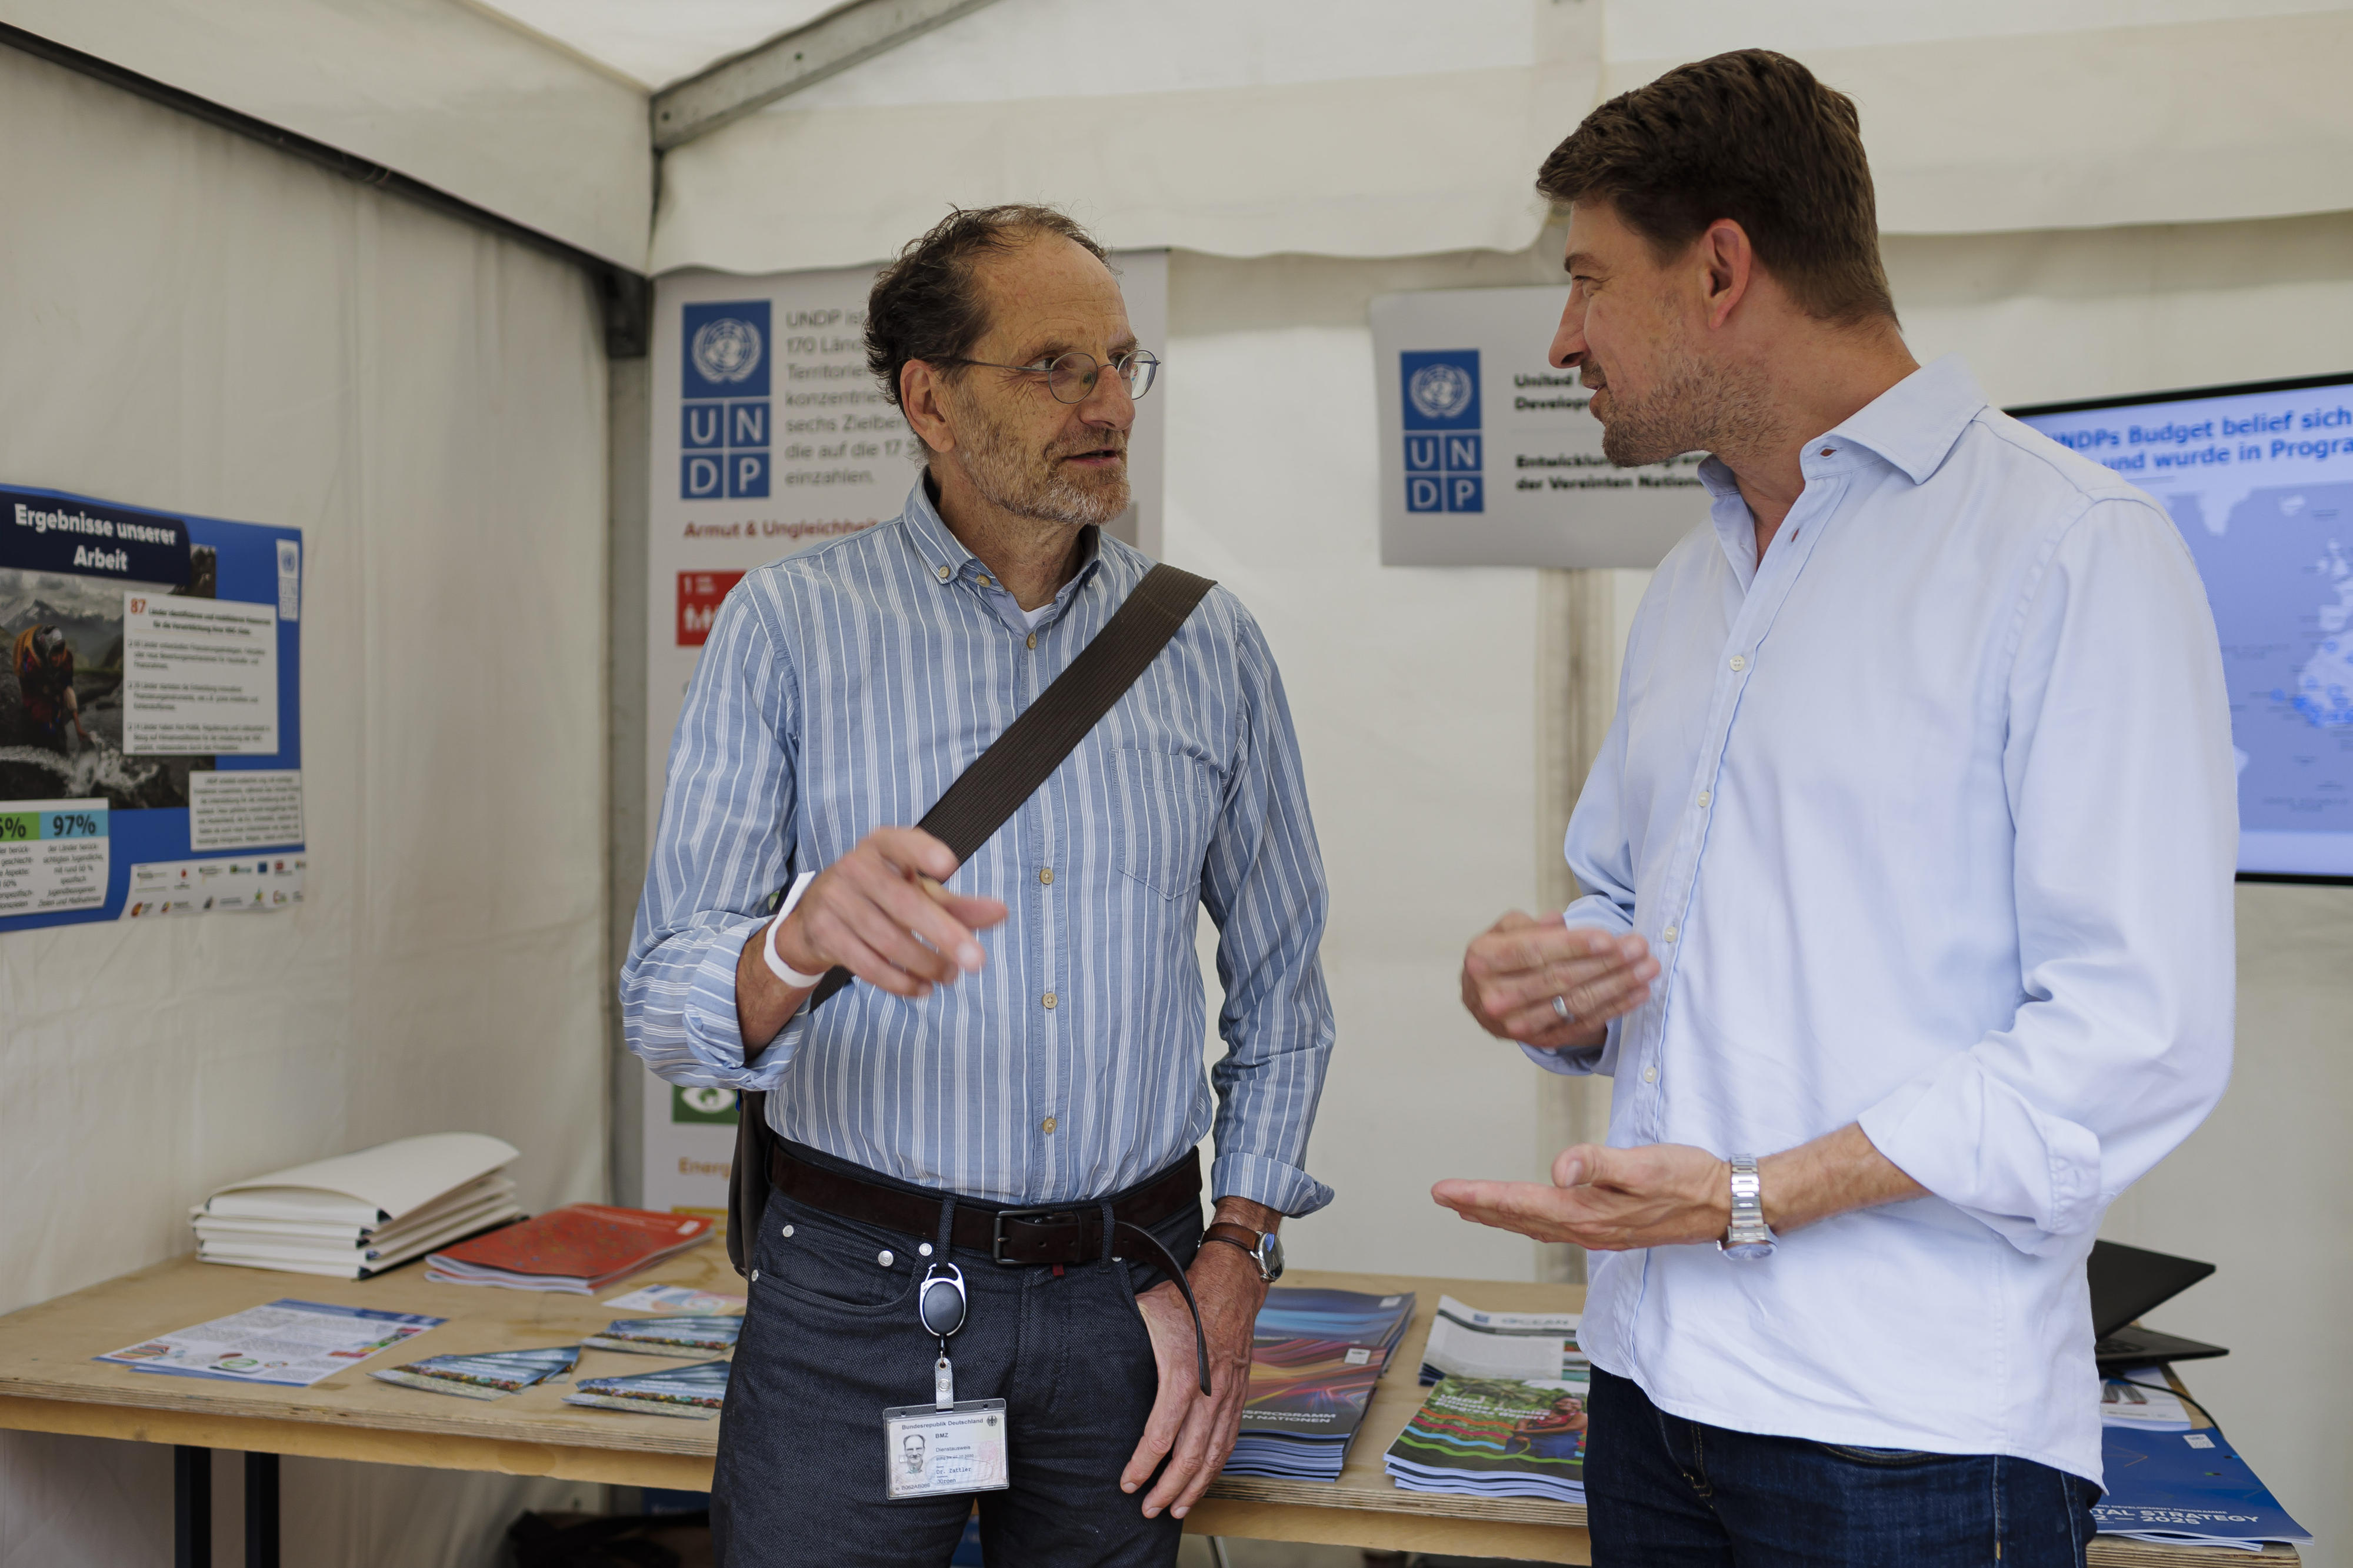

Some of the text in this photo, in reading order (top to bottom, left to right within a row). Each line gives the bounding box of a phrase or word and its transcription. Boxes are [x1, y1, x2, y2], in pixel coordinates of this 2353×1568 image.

[786, 309, 842, 329] UNDP
[786, 336, 816, 355] 170
[786, 363, 868, 381] Territorie
[1514, 372, 1573, 387] United
[785, 389, 884, 408] konzentrie
[785, 413, 903, 434] sechs Zielber
[2128, 419, 2214, 445] Budget
[2222, 411, 2294, 436] belief
[2301, 406, 2352, 429] sich
[785, 442, 813, 461] die
[818, 441, 847, 459] auf
[851, 441, 879, 459] die
[2154, 444, 2230, 467] wurde
[2239, 442, 2261, 461] in
[1516, 475, 1542, 490] der
[1548, 473, 1634, 489] Vereinten
[15, 503, 176, 546] Ergebnisse unserer
[684, 519, 739, 538] Armut
[745, 521, 758, 536] &
[73, 545, 128, 572] Arbeit
[131, 598, 146, 614] 87
[53, 814, 96, 836] 97%
[902, 1418, 984, 1430] Bundesrepublik Deutschland
[2140, 1510, 2259, 1522] STRATEGY
[2140, 1516, 2201, 1525] 2025
